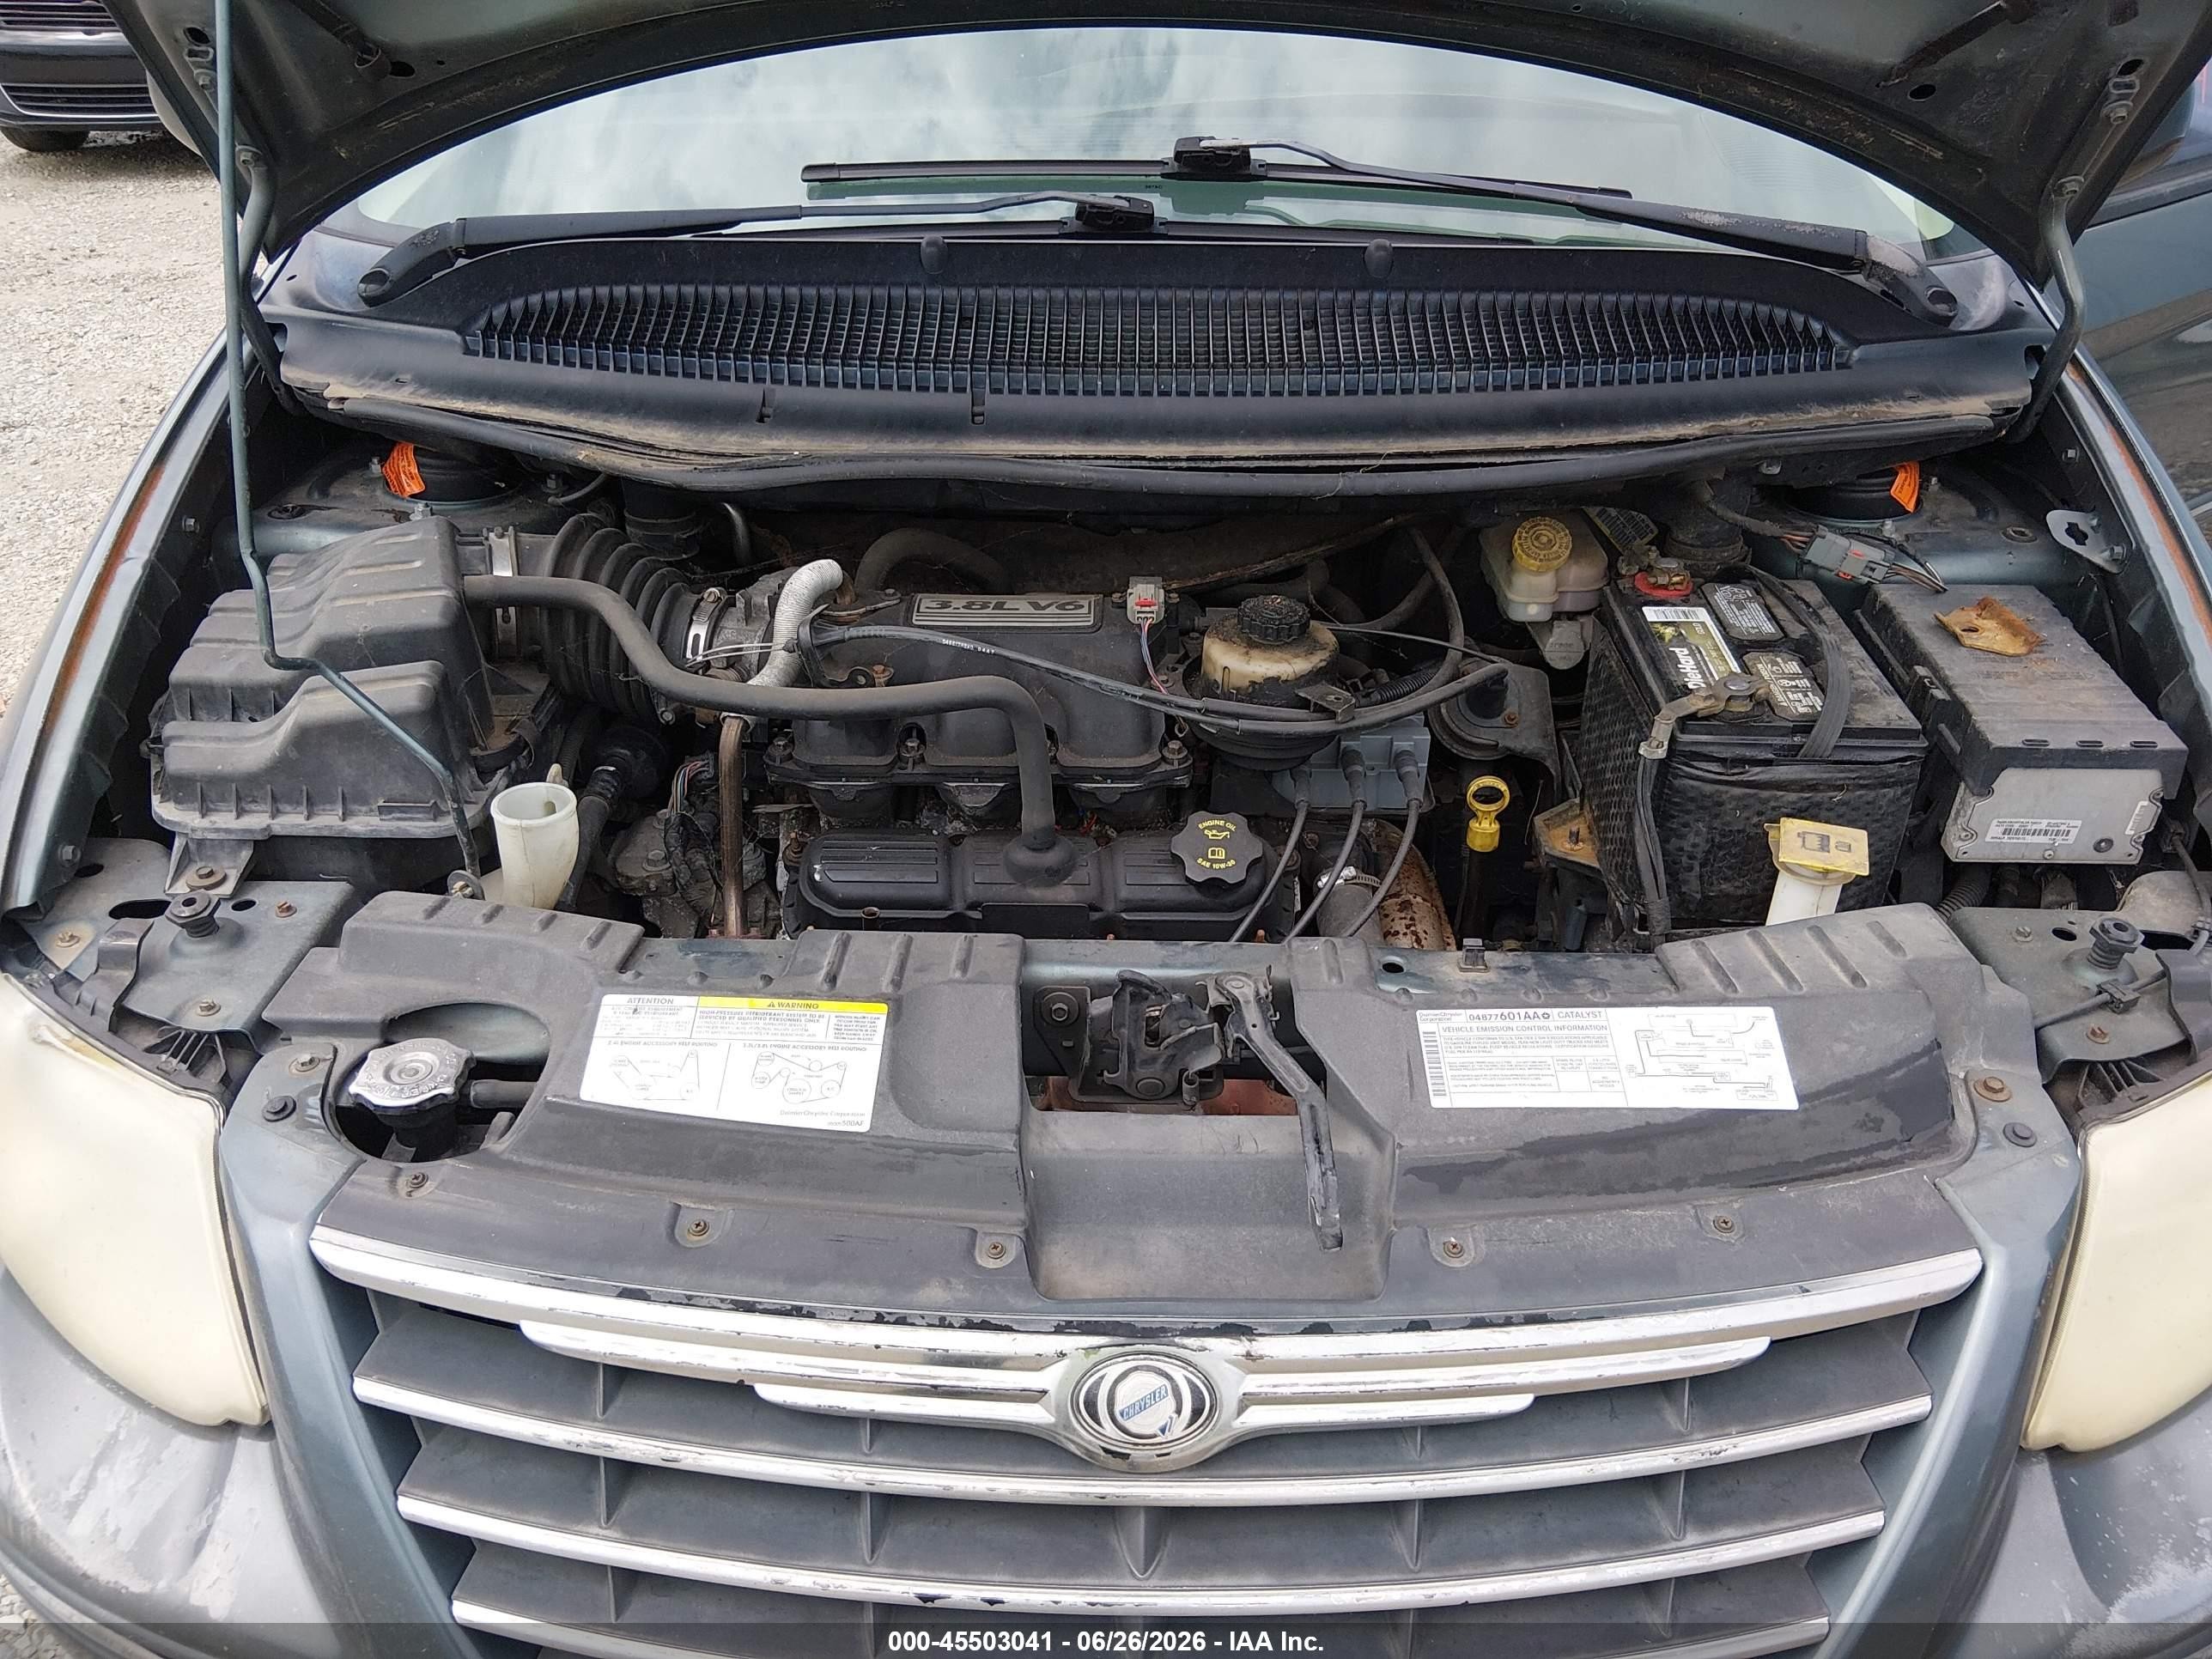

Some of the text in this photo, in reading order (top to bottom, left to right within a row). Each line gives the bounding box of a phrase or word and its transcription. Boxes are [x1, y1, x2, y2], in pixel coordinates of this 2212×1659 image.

[924, 599, 1085, 611] 3.8L V6
[1668, 647, 1707, 690] DieHard
[1198, 819, 1237, 832] ENGINE OIL
[1196, 857, 1237, 869] SAE 10W-30
[1468, 1011, 1540, 1022] 04877601AA
[1557, 1011, 1603, 1019] CATALYST
[1122, 1386, 1169, 1420] CHRYSLER
